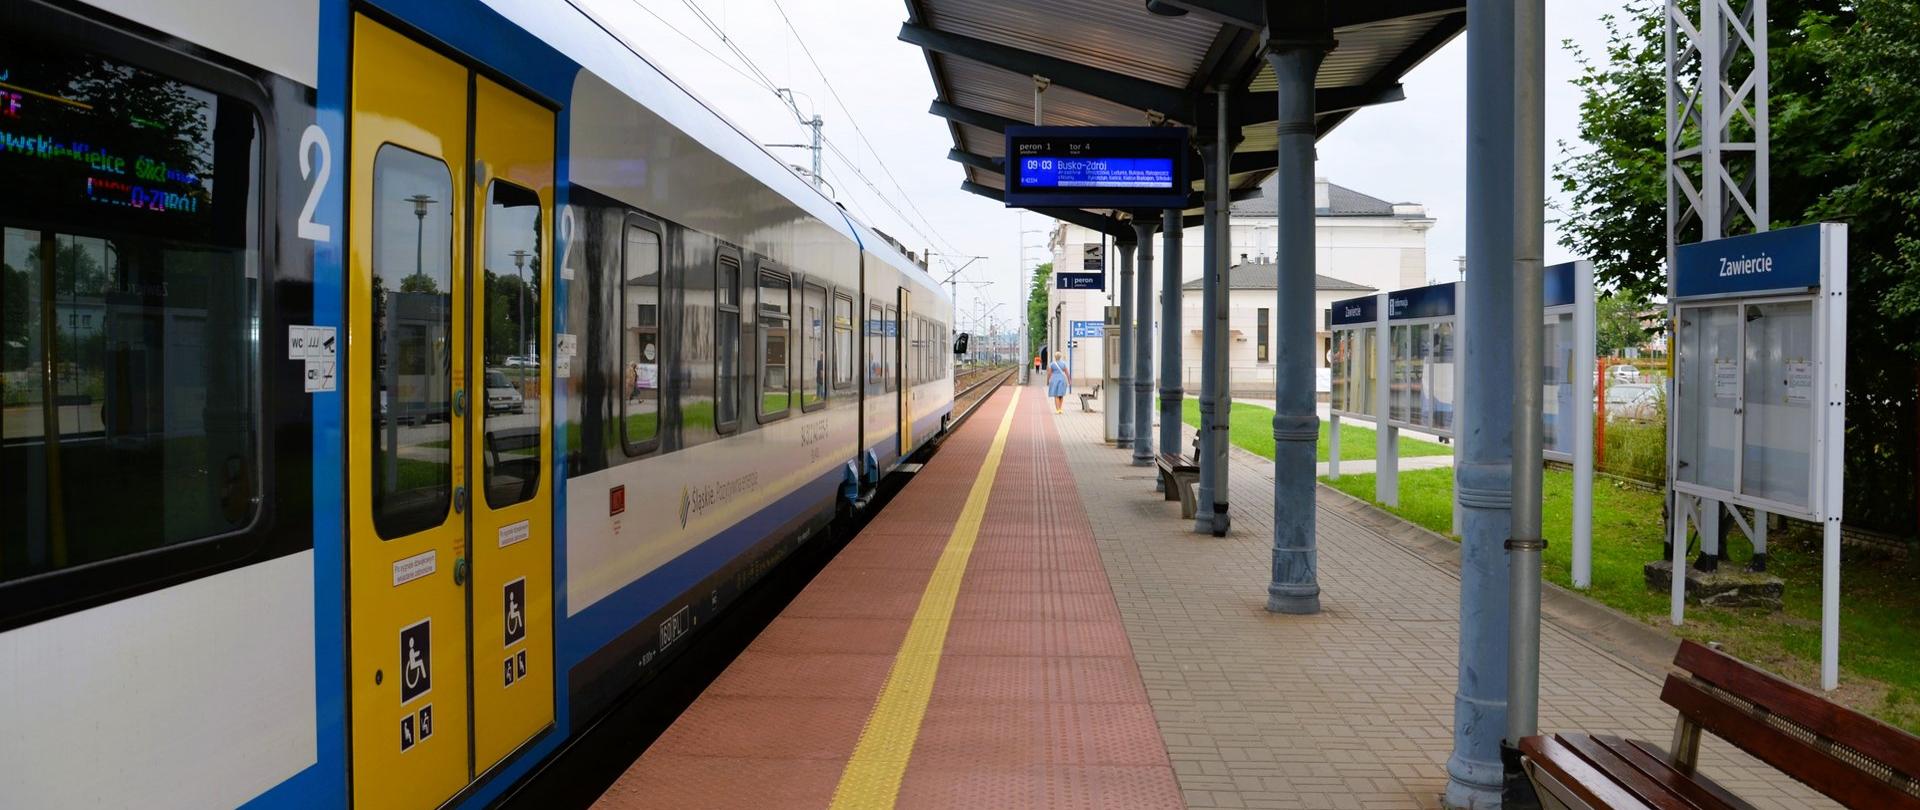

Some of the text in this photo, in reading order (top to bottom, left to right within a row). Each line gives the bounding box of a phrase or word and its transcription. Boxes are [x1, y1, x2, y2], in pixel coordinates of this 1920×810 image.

[1020, 142, 1051, 151] peron 1
[297, 124, 331, 242] 2
[560, 204, 575, 280] 2
[1719, 252, 1773, 277] Zawiercie
[1063, 277, 1068, 288] 1
[291, 337, 303, 348] WC
